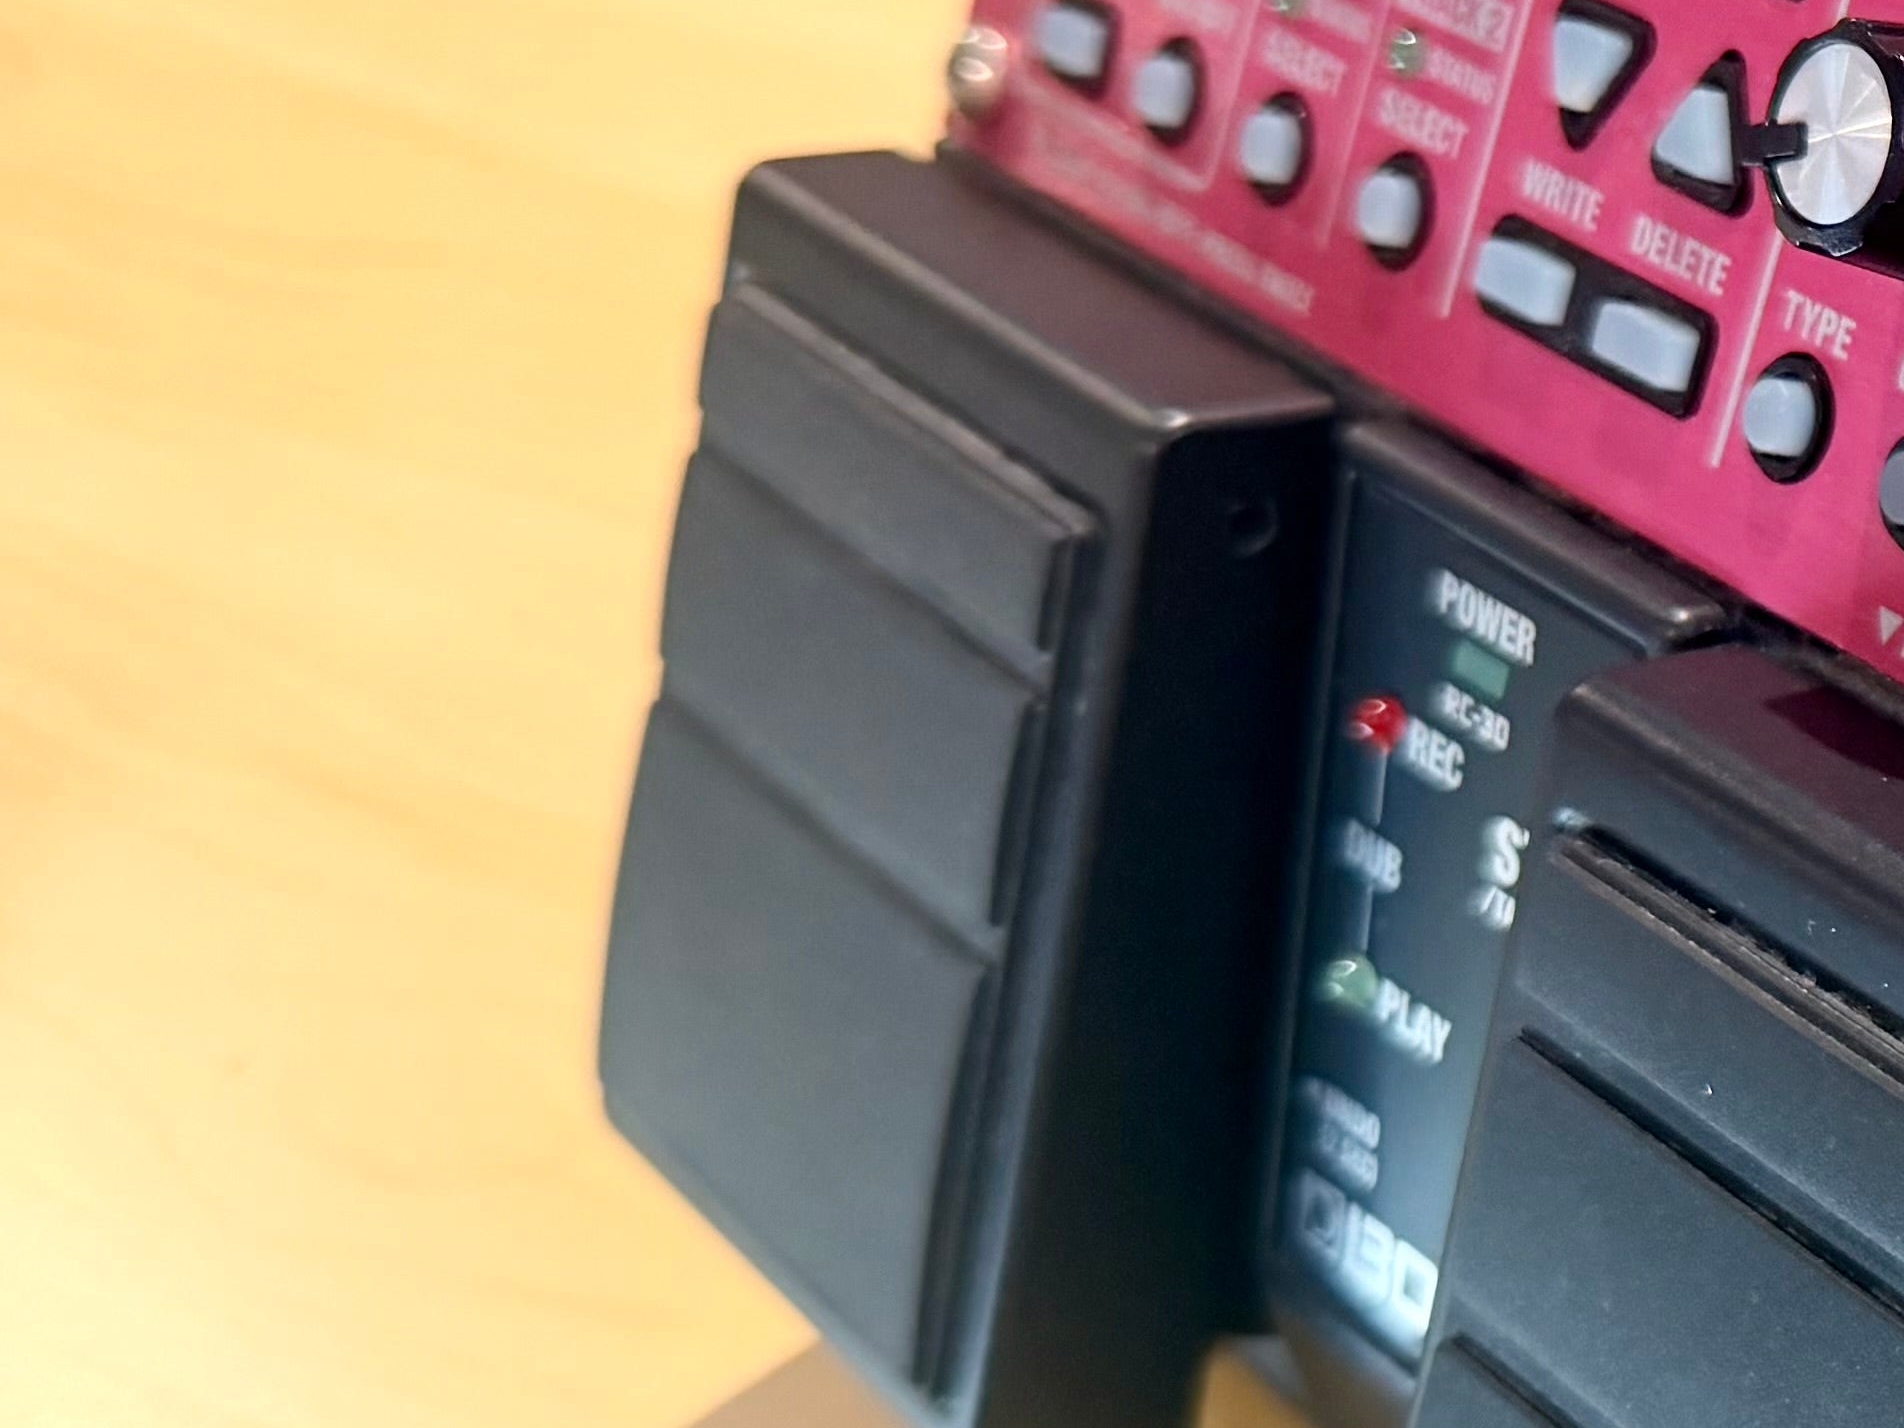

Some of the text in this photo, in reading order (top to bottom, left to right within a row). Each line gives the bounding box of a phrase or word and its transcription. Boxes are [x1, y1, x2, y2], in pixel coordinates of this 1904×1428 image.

[1262, 26, 1347, 97] SELECT
[1378, 85, 1469, 158] SELECT
[1523, 158, 1603, 232] WRITE
[1630, 217, 1732, 296] DELETE
[1781, 289, 1857, 360] TYPE
[1436, 567, 1537, 667] POWER
[1405, 715, 1466, 792] REC
[1440, 681, 1511, 752] RC-30
[1344, 818, 1403, 893] DUB
[1375, 976, 1452, 1063] PLAY
